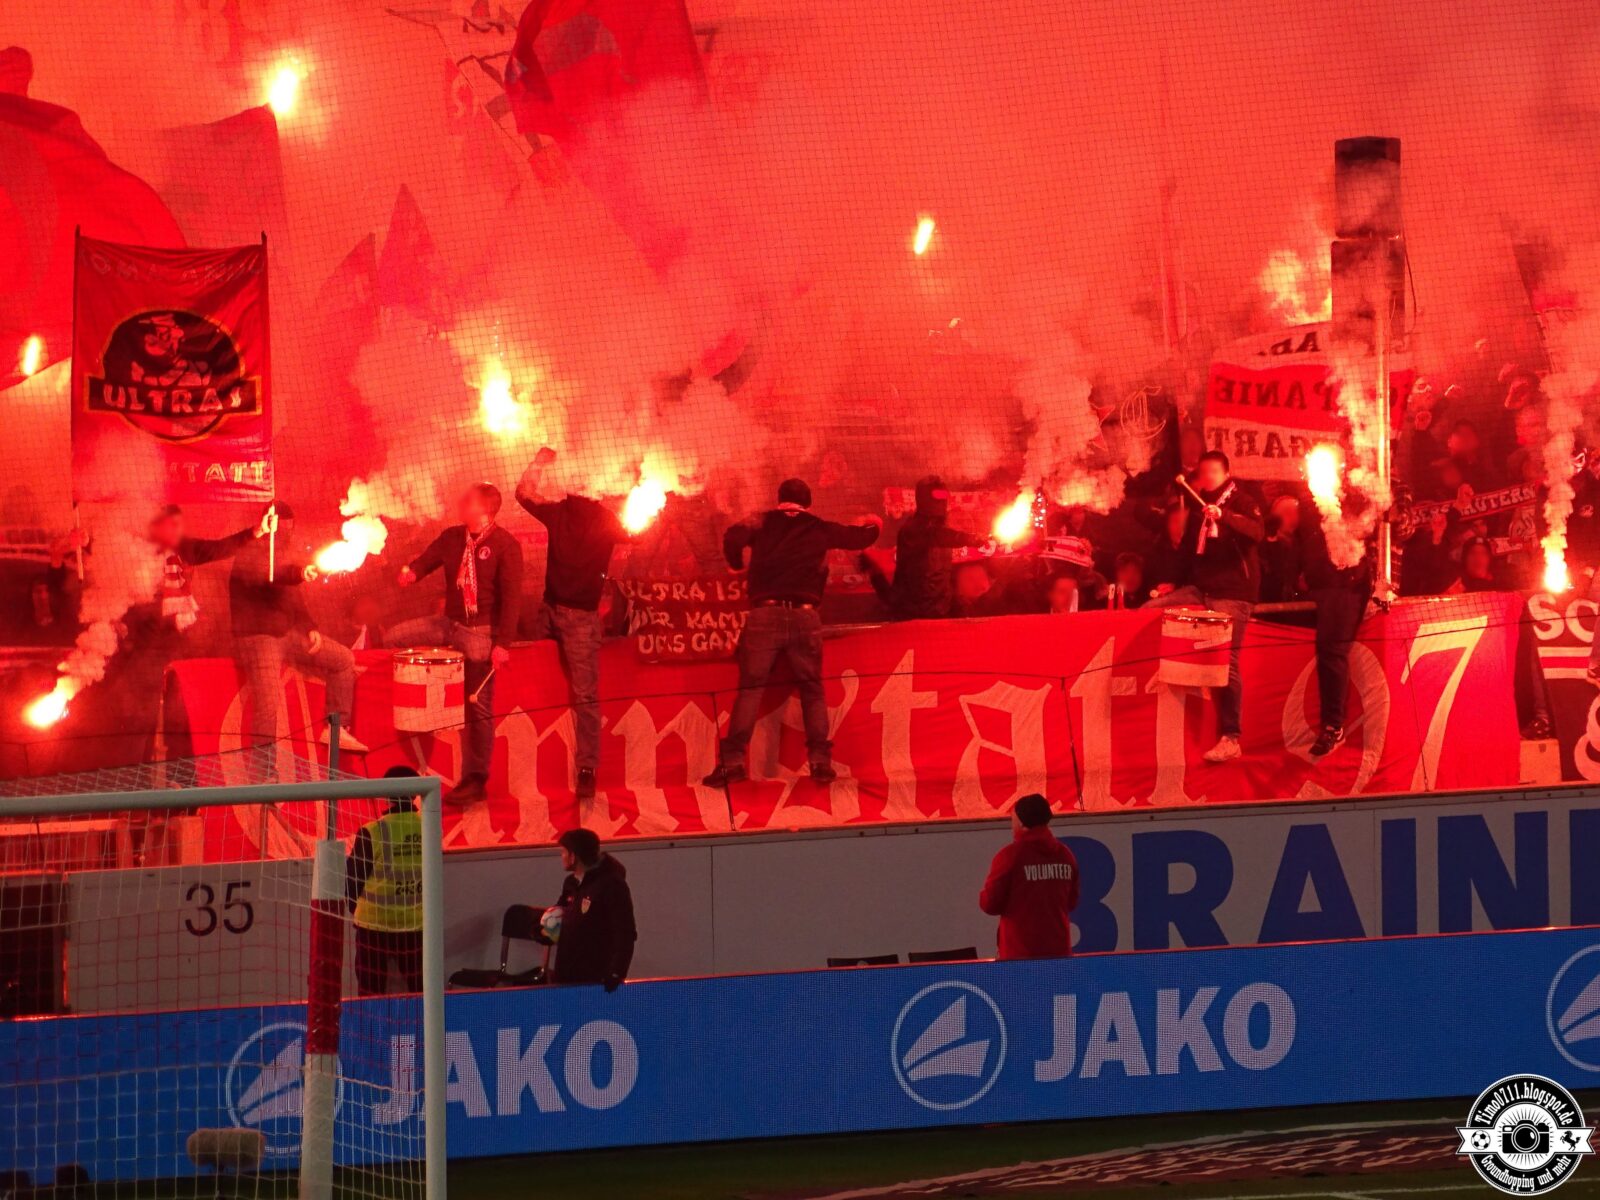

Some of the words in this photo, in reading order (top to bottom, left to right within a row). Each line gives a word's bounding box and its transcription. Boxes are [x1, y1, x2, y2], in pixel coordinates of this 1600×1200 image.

[686, 610, 750, 630] KAM
[691, 629, 741, 653] GAN
[1023, 863, 1073, 881] VOLUNTEER
[184, 881, 255, 937] 35
[1033, 982, 1297, 1083] JAKO
[373, 1018, 640, 1126] JAKO
